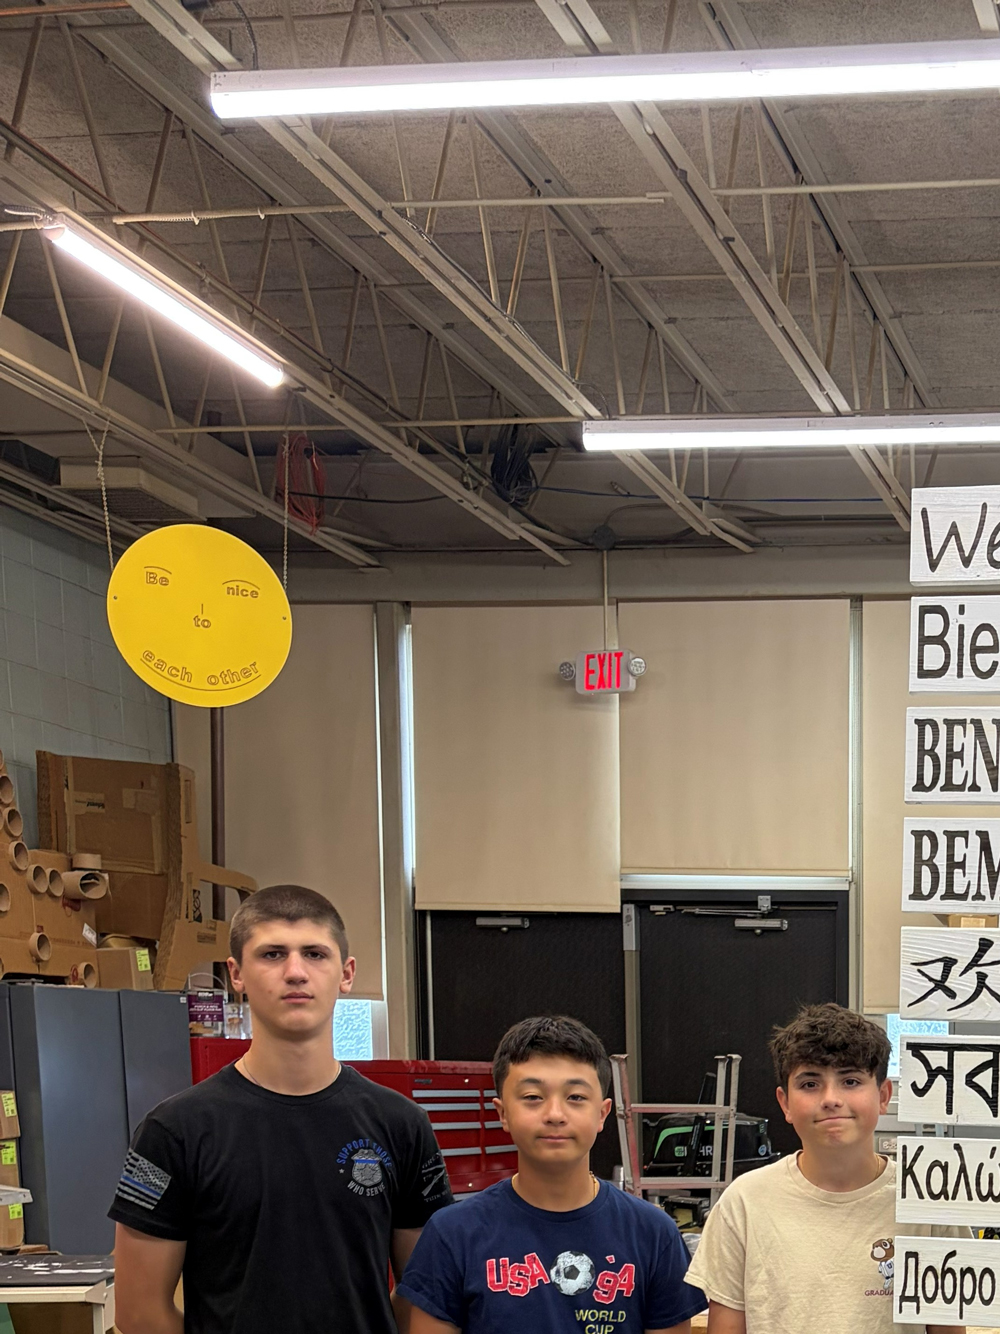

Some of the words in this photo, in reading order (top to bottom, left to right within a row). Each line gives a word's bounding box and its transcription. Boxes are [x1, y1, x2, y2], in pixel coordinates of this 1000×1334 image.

[145, 571, 170, 586] Be
[226, 585, 259, 599] nice
[193, 615, 211, 629] to
[142, 650, 193, 683] each
[206, 661, 259, 685] other
[584, 651, 623, 690] EXIT
[336, 1138, 370, 1165] SUPPORT
[372, 1142, 393, 1168] THOSE
[347, 1180, 365, 1196] WHO
[366, 1181, 386, 1197] SERVE
[486, 1252, 550, 1297] USA
[898, 1250, 996, 1320] Добро
[575, 1309, 627, 1324] WORLD
